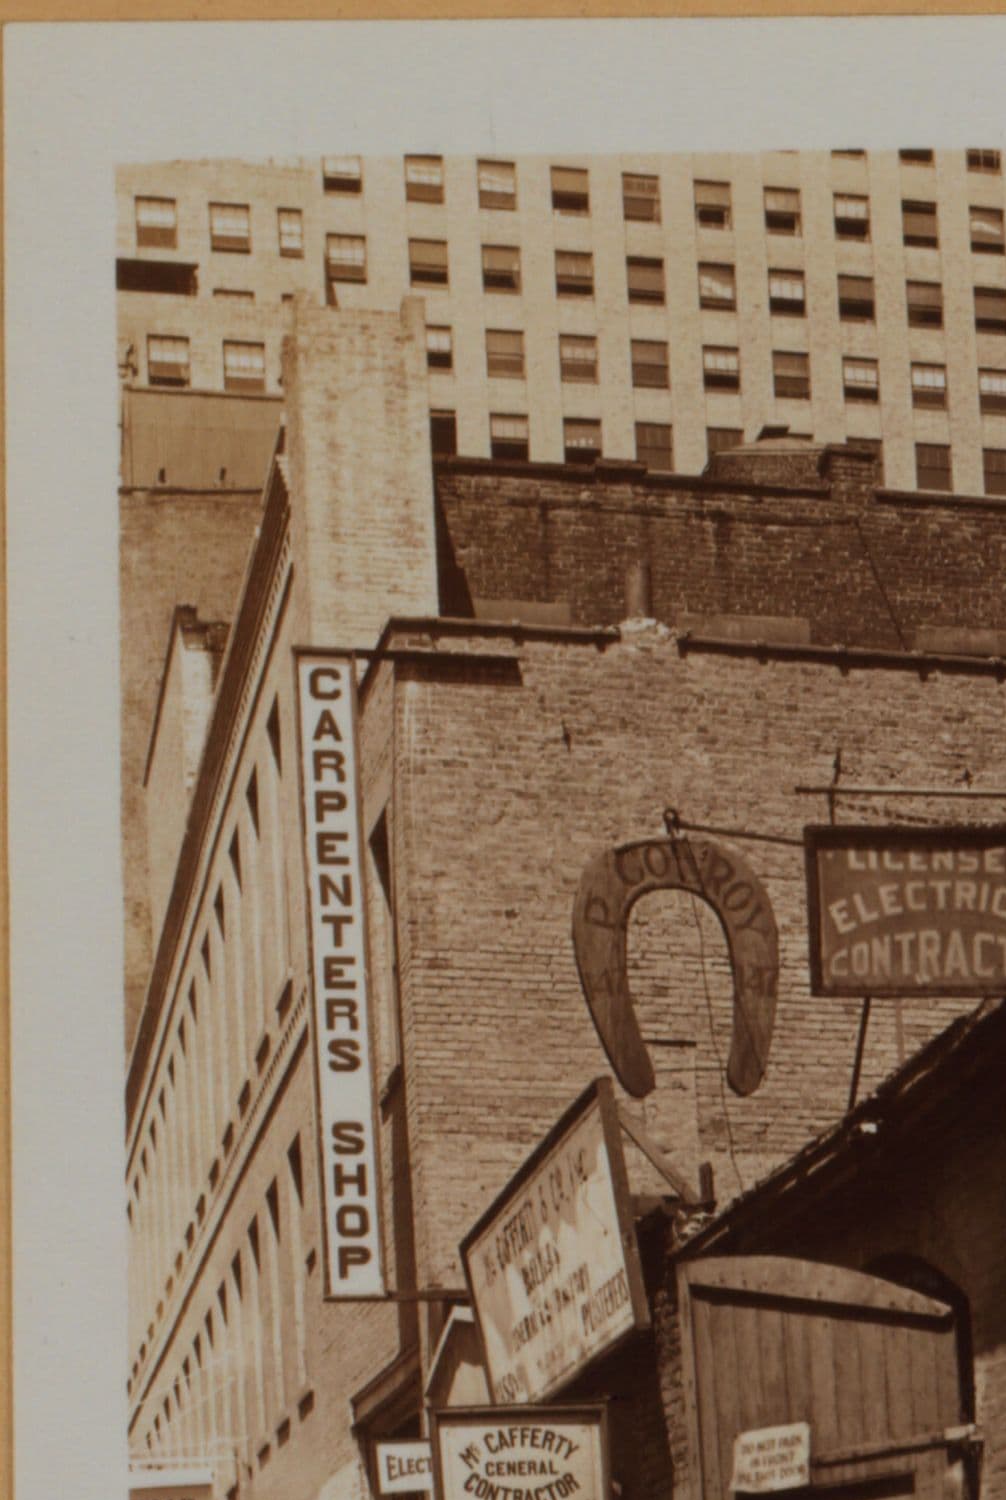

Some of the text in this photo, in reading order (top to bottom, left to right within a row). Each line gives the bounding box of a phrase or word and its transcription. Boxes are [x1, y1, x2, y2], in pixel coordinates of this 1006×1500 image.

[308, 666, 375, 1280] CARPENTERS SHOP
[483, 1427, 580, 1461] CAFFERTY
[485, 1461, 559, 1478] GENERAL
